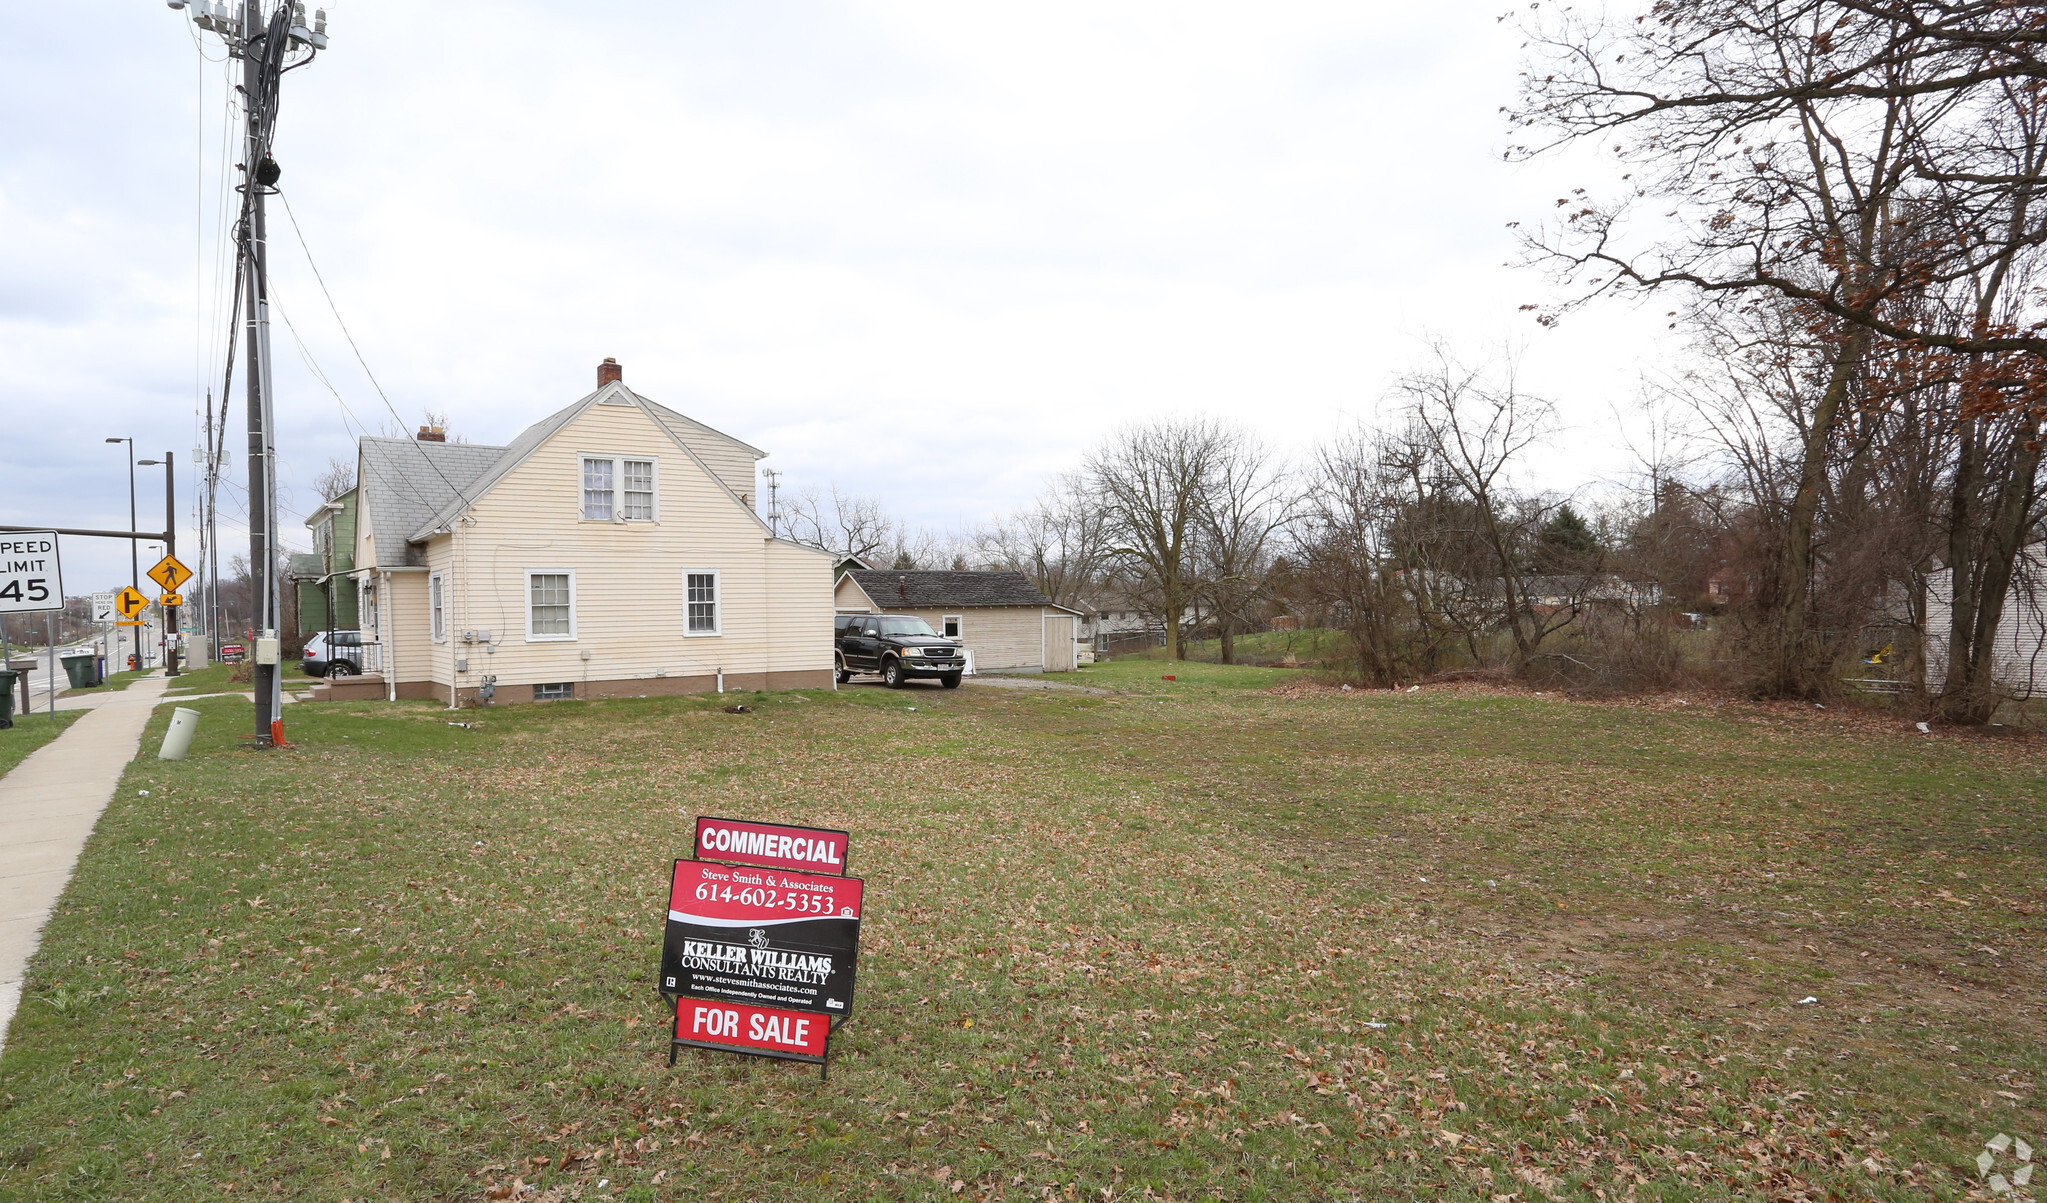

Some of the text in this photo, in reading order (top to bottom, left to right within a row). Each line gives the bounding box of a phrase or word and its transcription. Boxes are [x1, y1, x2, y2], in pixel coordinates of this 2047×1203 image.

[0, 541, 52, 554] PEED
[0, 579, 49, 602] 45
[702, 827, 839, 865] COMMERCIAL
[702, 868, 833, 893] Steve Smith & Associates
[696, 883, 834, 915] 614-602-5353
[682, 955, 829, 985] CONSULTANTS REALTY
[683, 941, 832, 974] KELLER WILLIAMS
[692, 973, 817, 995] www.stevesmithassociates.com
[705, 985, 720, 993] Office
[721, 987, 757, 1000] Independently
[788, 996, 812, 1005] Operated
[693, 1007, 809, 1046] FOR SALE
